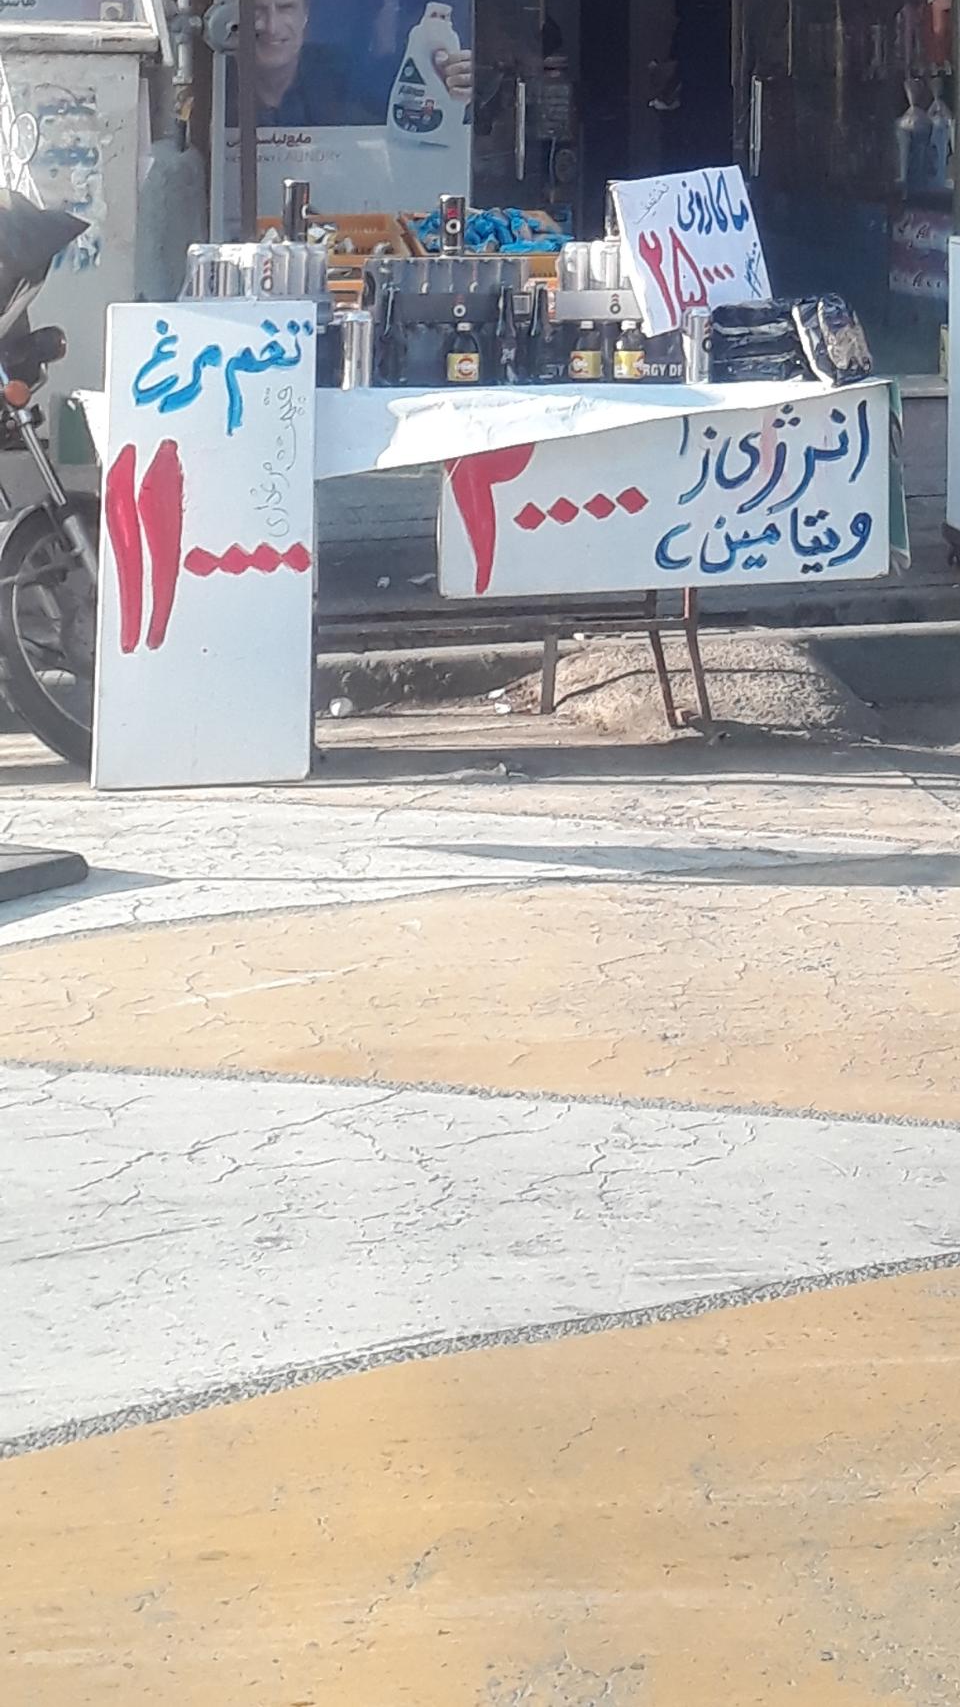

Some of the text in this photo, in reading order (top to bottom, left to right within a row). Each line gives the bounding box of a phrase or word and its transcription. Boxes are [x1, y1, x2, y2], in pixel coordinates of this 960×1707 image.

[677, 170, 749, 235] ماکارونی
[638, 226, 735, 327] ۲۵۰۰۰
[714, 400, 869, 515] انرژی
[699, 507, 872, 575] ویتامین
